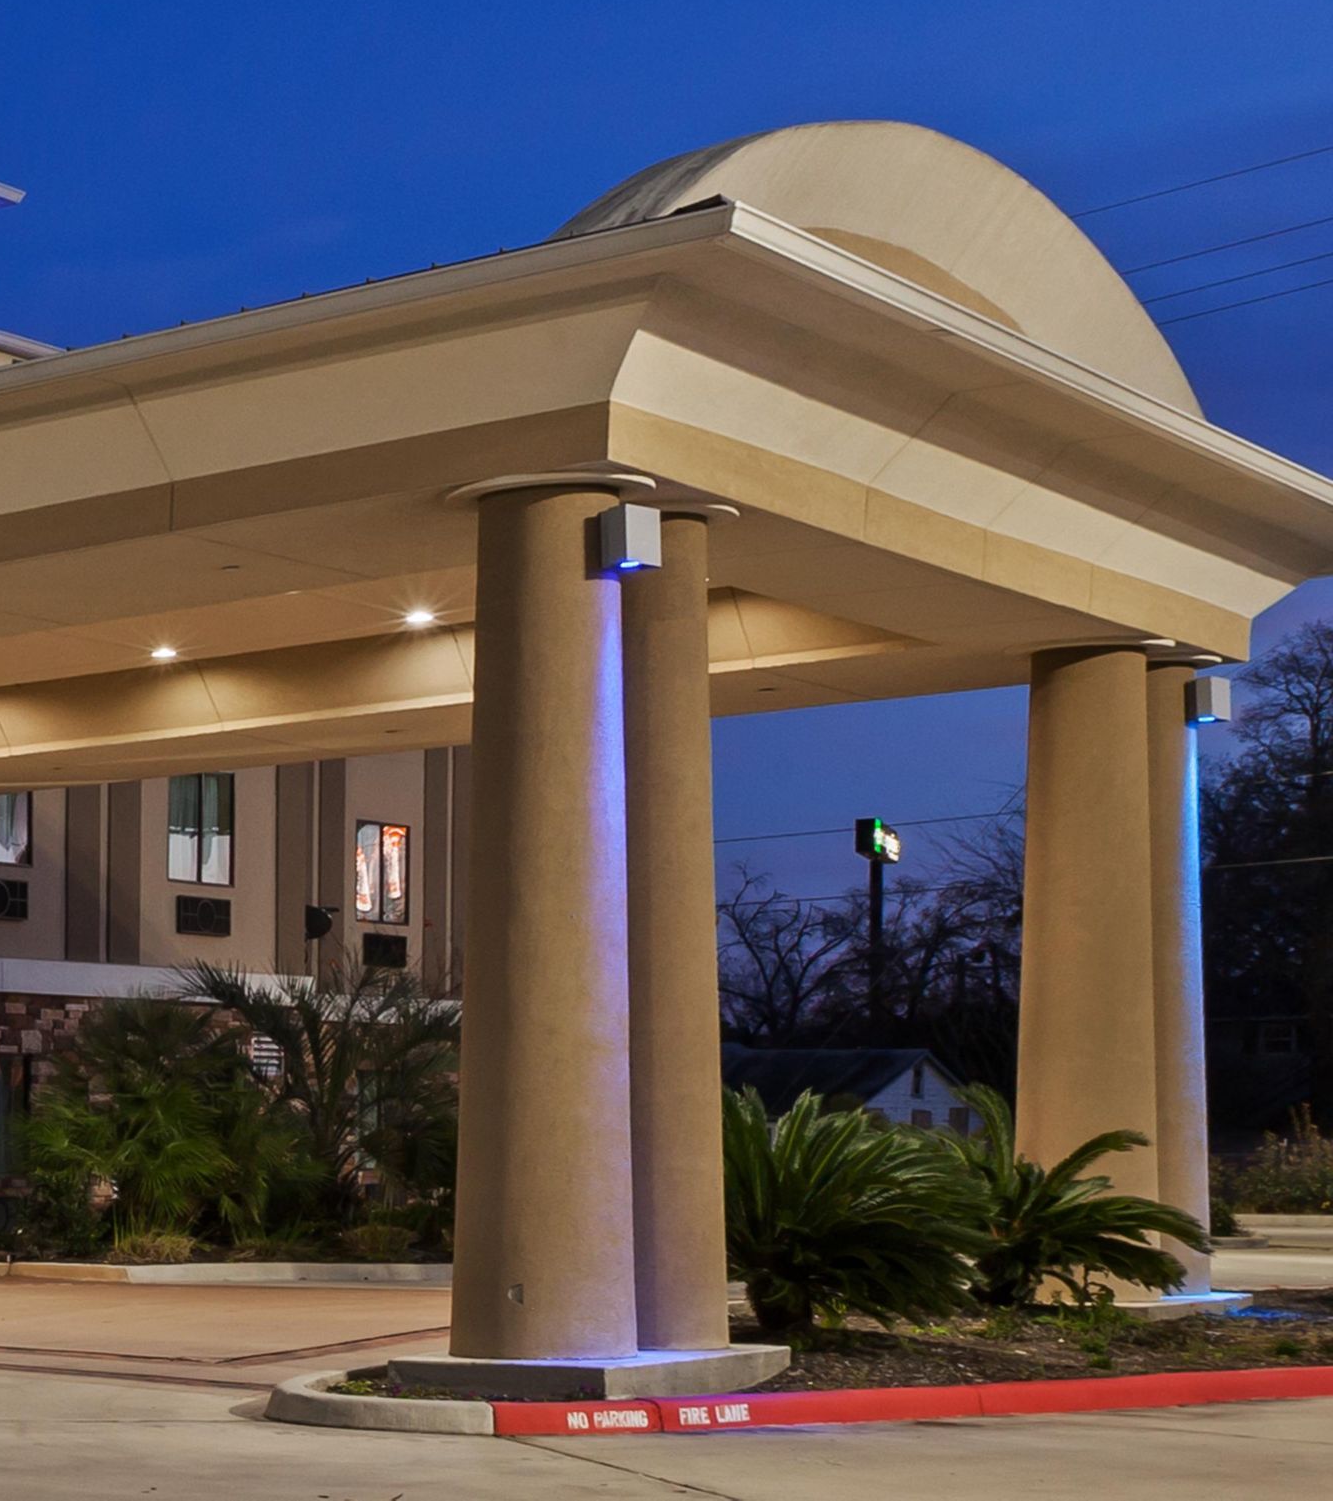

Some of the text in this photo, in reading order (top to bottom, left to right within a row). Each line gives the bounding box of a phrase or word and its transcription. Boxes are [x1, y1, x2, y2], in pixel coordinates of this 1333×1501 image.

[567, 1404, 750, 1429] NO PARKING FIRE LANE
